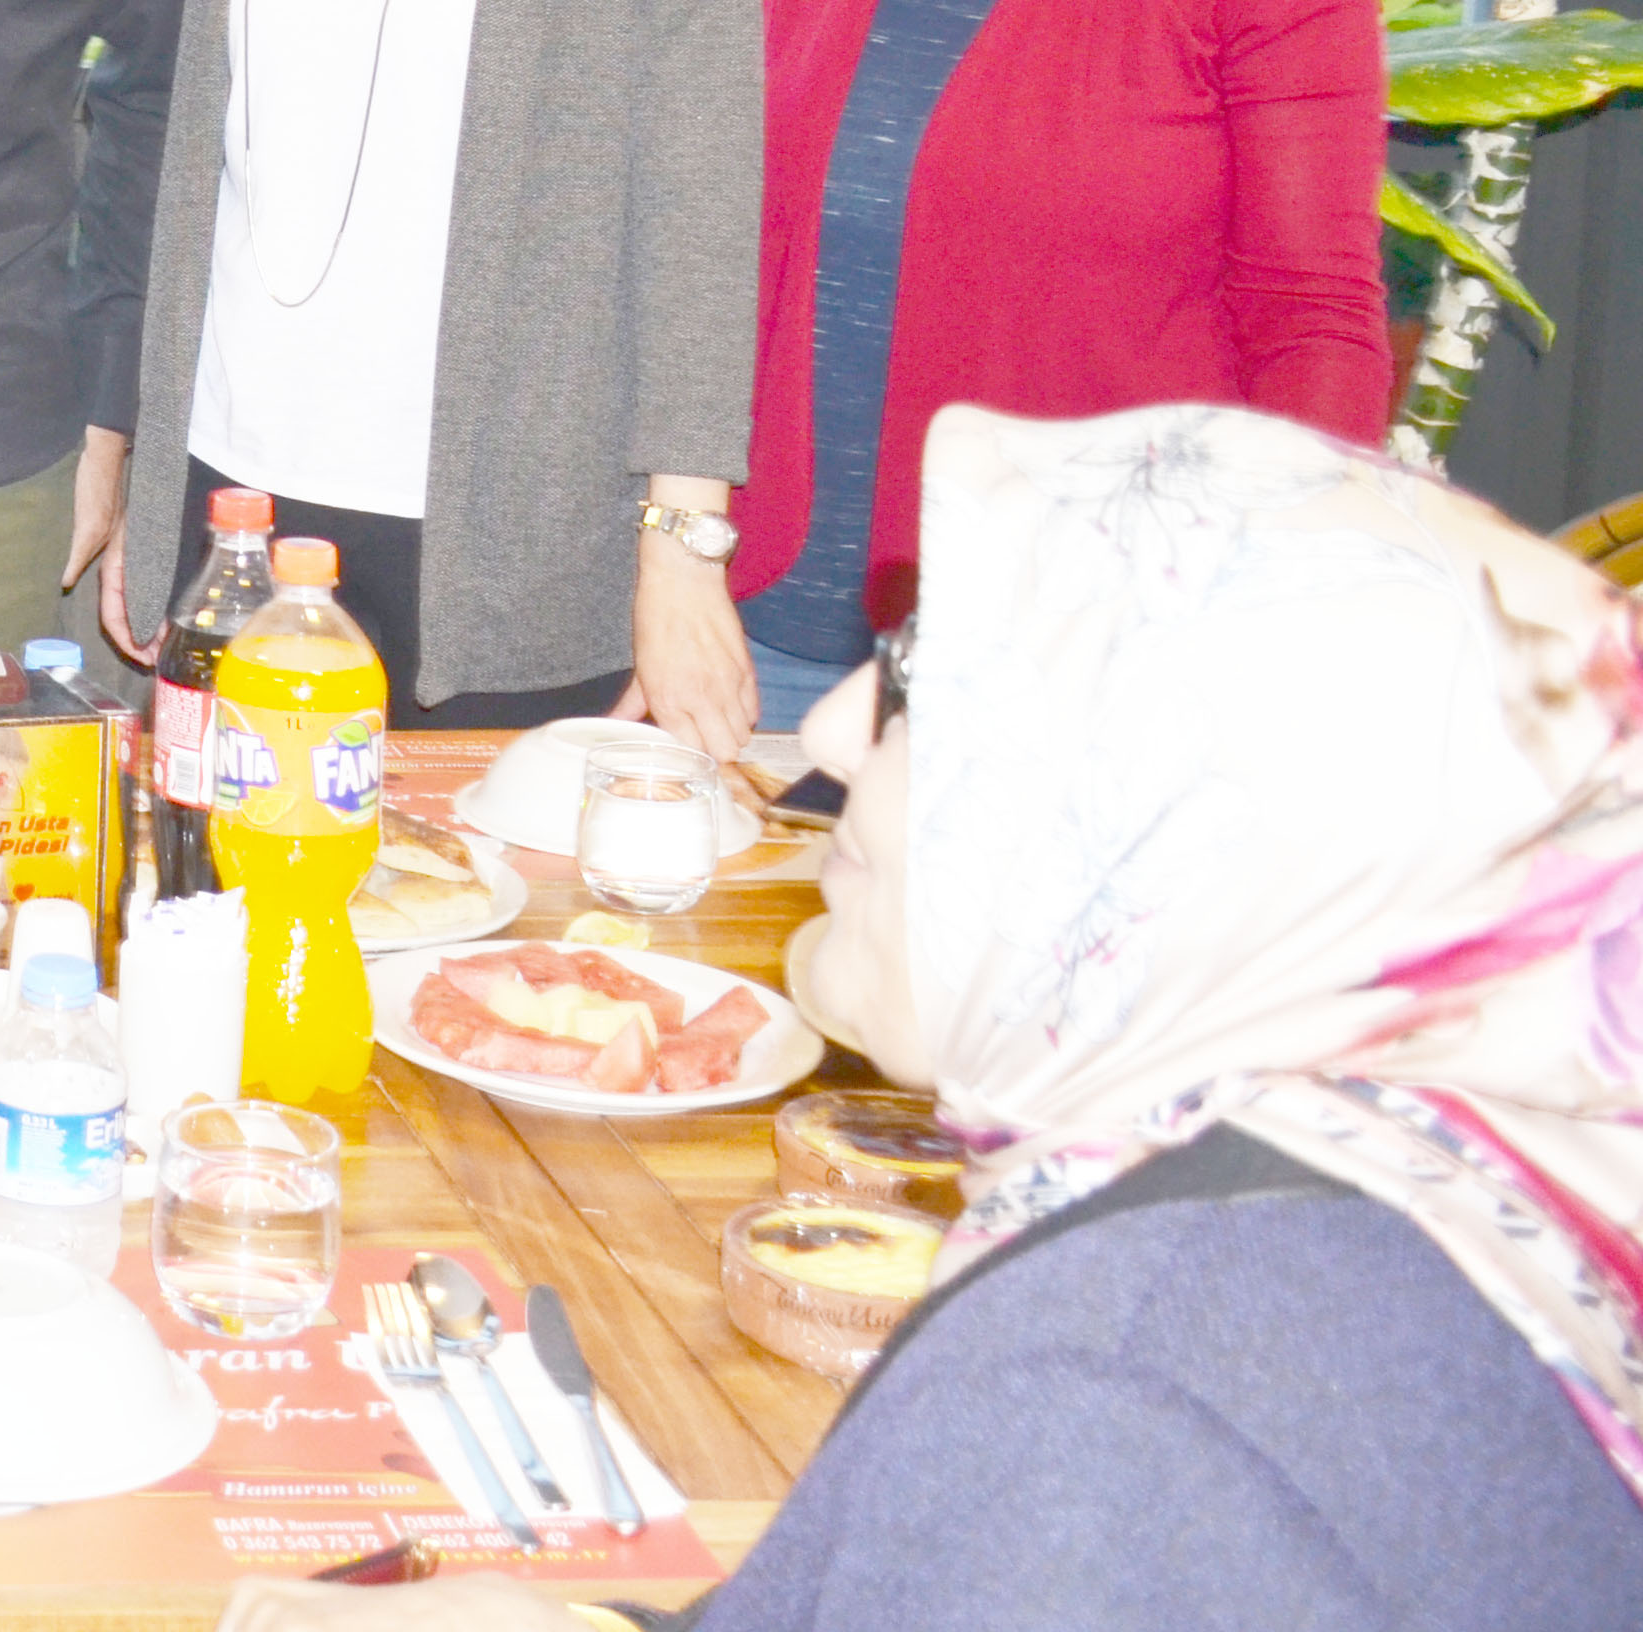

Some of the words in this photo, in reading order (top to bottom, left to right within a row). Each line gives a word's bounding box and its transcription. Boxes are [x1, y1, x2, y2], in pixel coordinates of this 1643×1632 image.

[217, 728, 277, 782] NTA
[313, 733, 382, 800] FAN
[18, 816, 70, 833] Usta
[182, 1349, 312, 1371] ran
[224, 1481, 349, 1497] Hamurun
[214, 1516, 284, 1532] BAFRA
[241, 1535, 280, 1550] 362
[324, 1534, 352, 1549] 75
